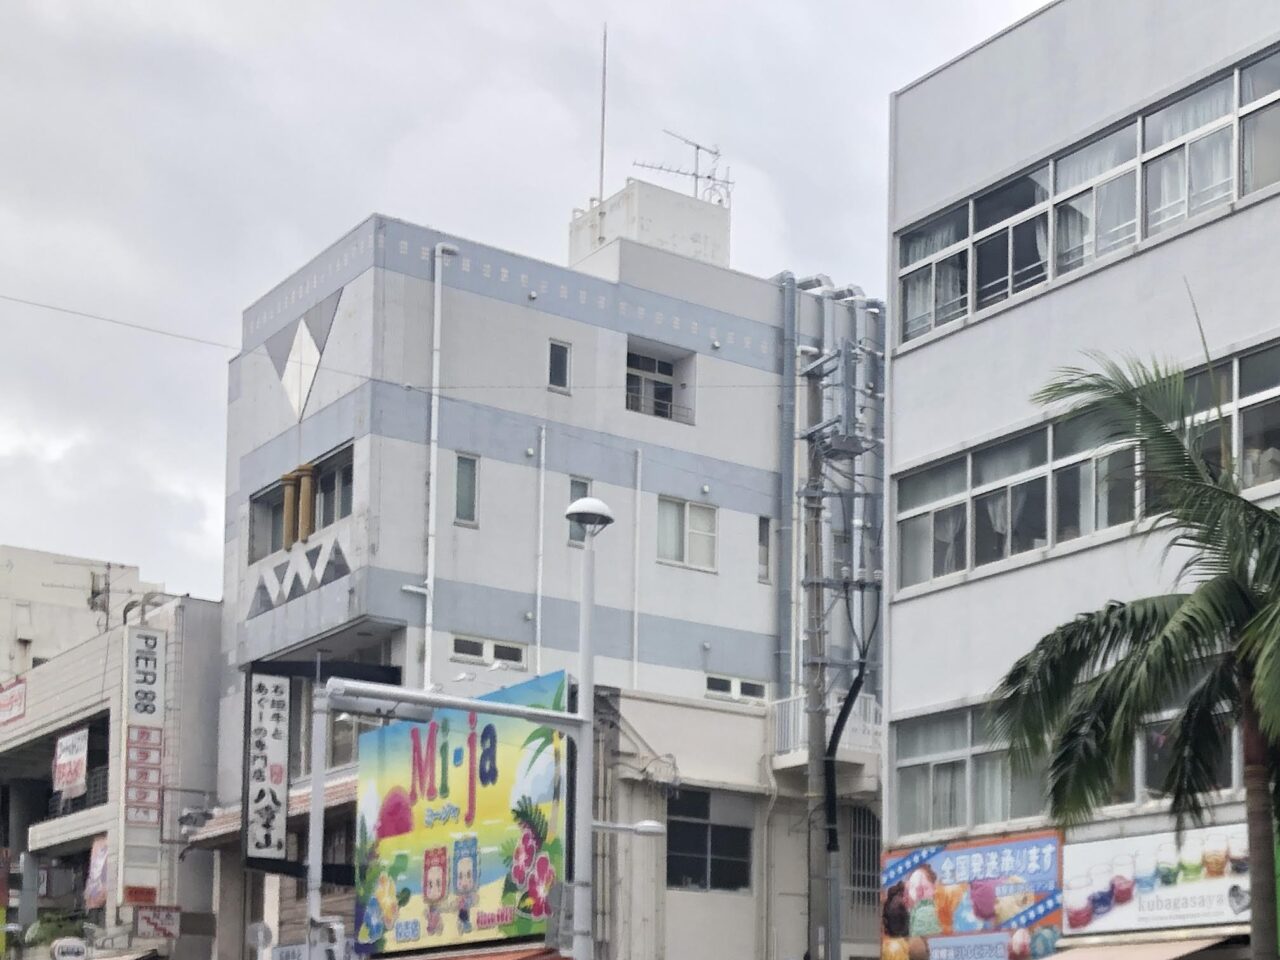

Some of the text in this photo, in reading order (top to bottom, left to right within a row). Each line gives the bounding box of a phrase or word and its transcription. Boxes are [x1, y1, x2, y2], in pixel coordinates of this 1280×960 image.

[135, 633, 158, 685] PIER
[134, 689, 157, 715] 88
[940, 843, 1056, 884] 全国発送承ります
[1138, 893, 1225, 912] kubagasaya
